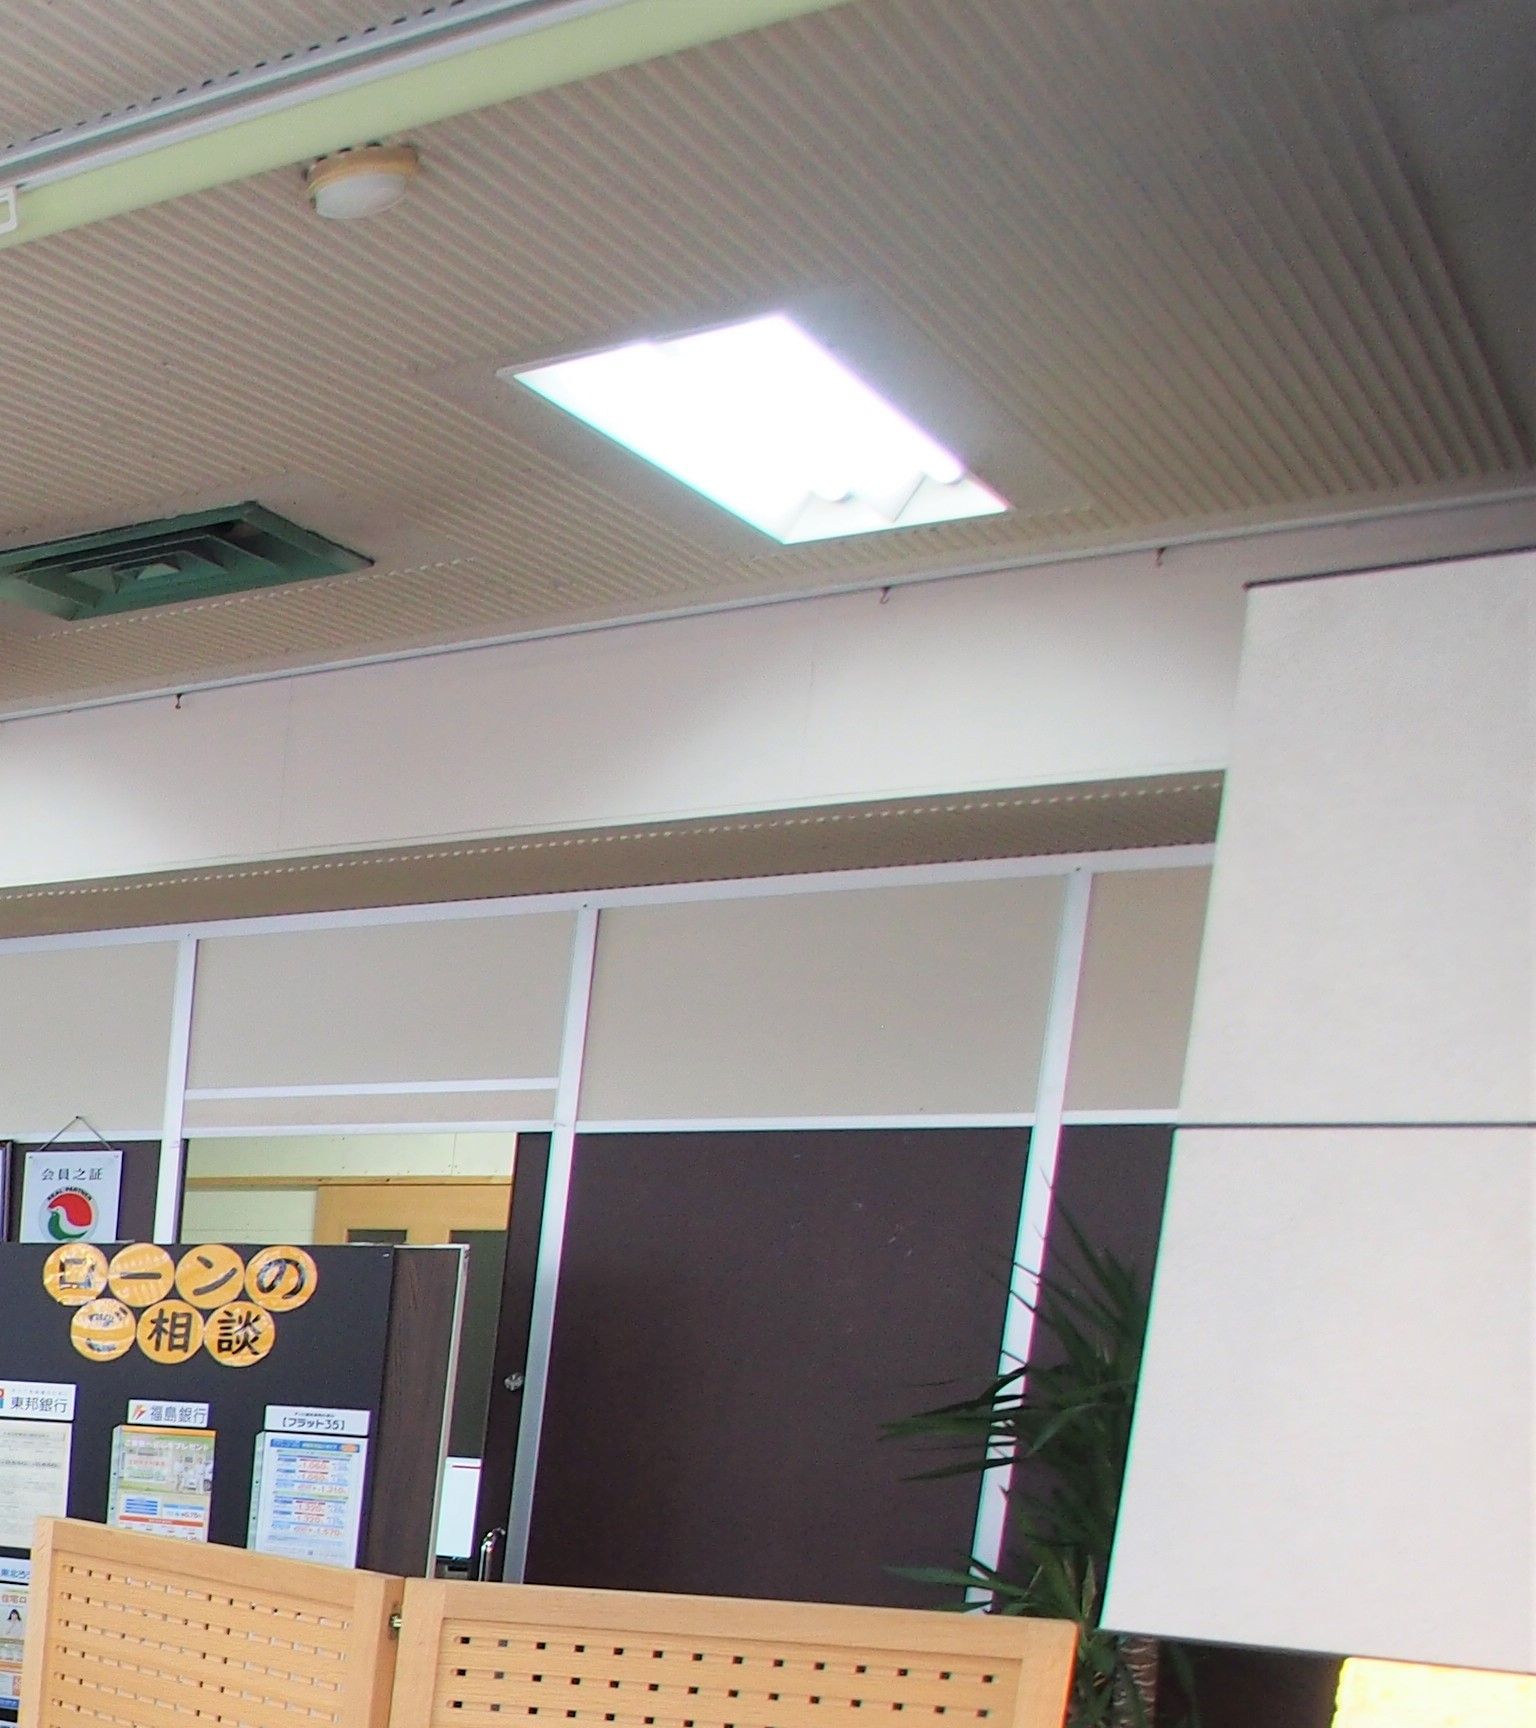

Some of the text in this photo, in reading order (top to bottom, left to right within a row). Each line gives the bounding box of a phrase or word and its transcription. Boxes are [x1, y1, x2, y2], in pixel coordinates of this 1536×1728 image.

[41, 1167, 105, 1182] 会員之証
[55, 1255, 307, 1298] ローンの
[85, 1306, 262, 1357] ご相談
[10, 1396, 68, 1413] 東邦銀行
[150, 1405, 207, 1425] 福島銀行
